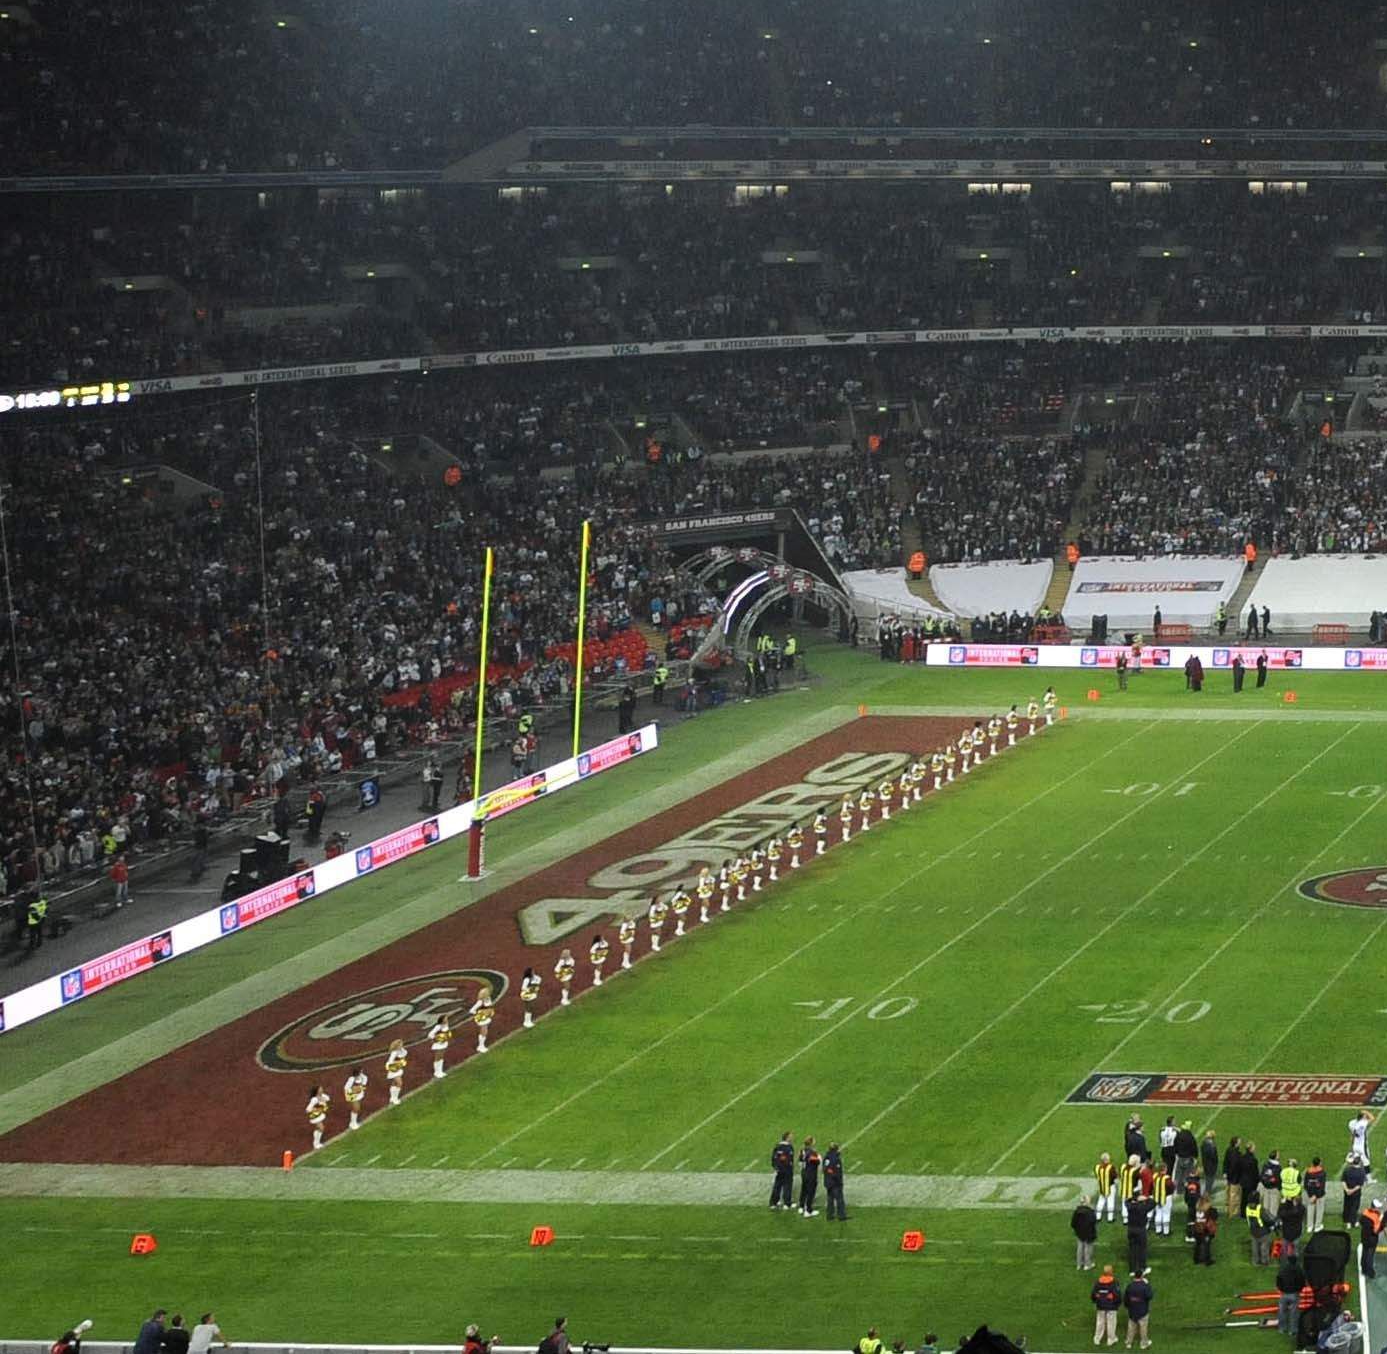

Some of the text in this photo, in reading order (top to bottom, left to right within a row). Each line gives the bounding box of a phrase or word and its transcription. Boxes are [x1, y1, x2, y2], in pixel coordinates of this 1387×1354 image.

[926, 330, 970, 341] Canon
[1040, 328, 1065, 339] VISA
[1318, 326, 1359, 336] Canon
[612, 344, 640, 356] VISA
[141, 379, 172, 392] VISA
[665, 520, 688, 532] SAN
[689, 515, 743, 530] FRANCISCO
[520, 751, 915, 945] 49ERS
[240, 882, 298, 913] INTERNATIONAL
[84, 944, 153, 982] INTERNATIONAL
[102, 961, 137, 981] SERIES
[1099, 1000, 1212, 1025] 20
[1162, 1078, 1366, 1096] INTERNATIONAL
